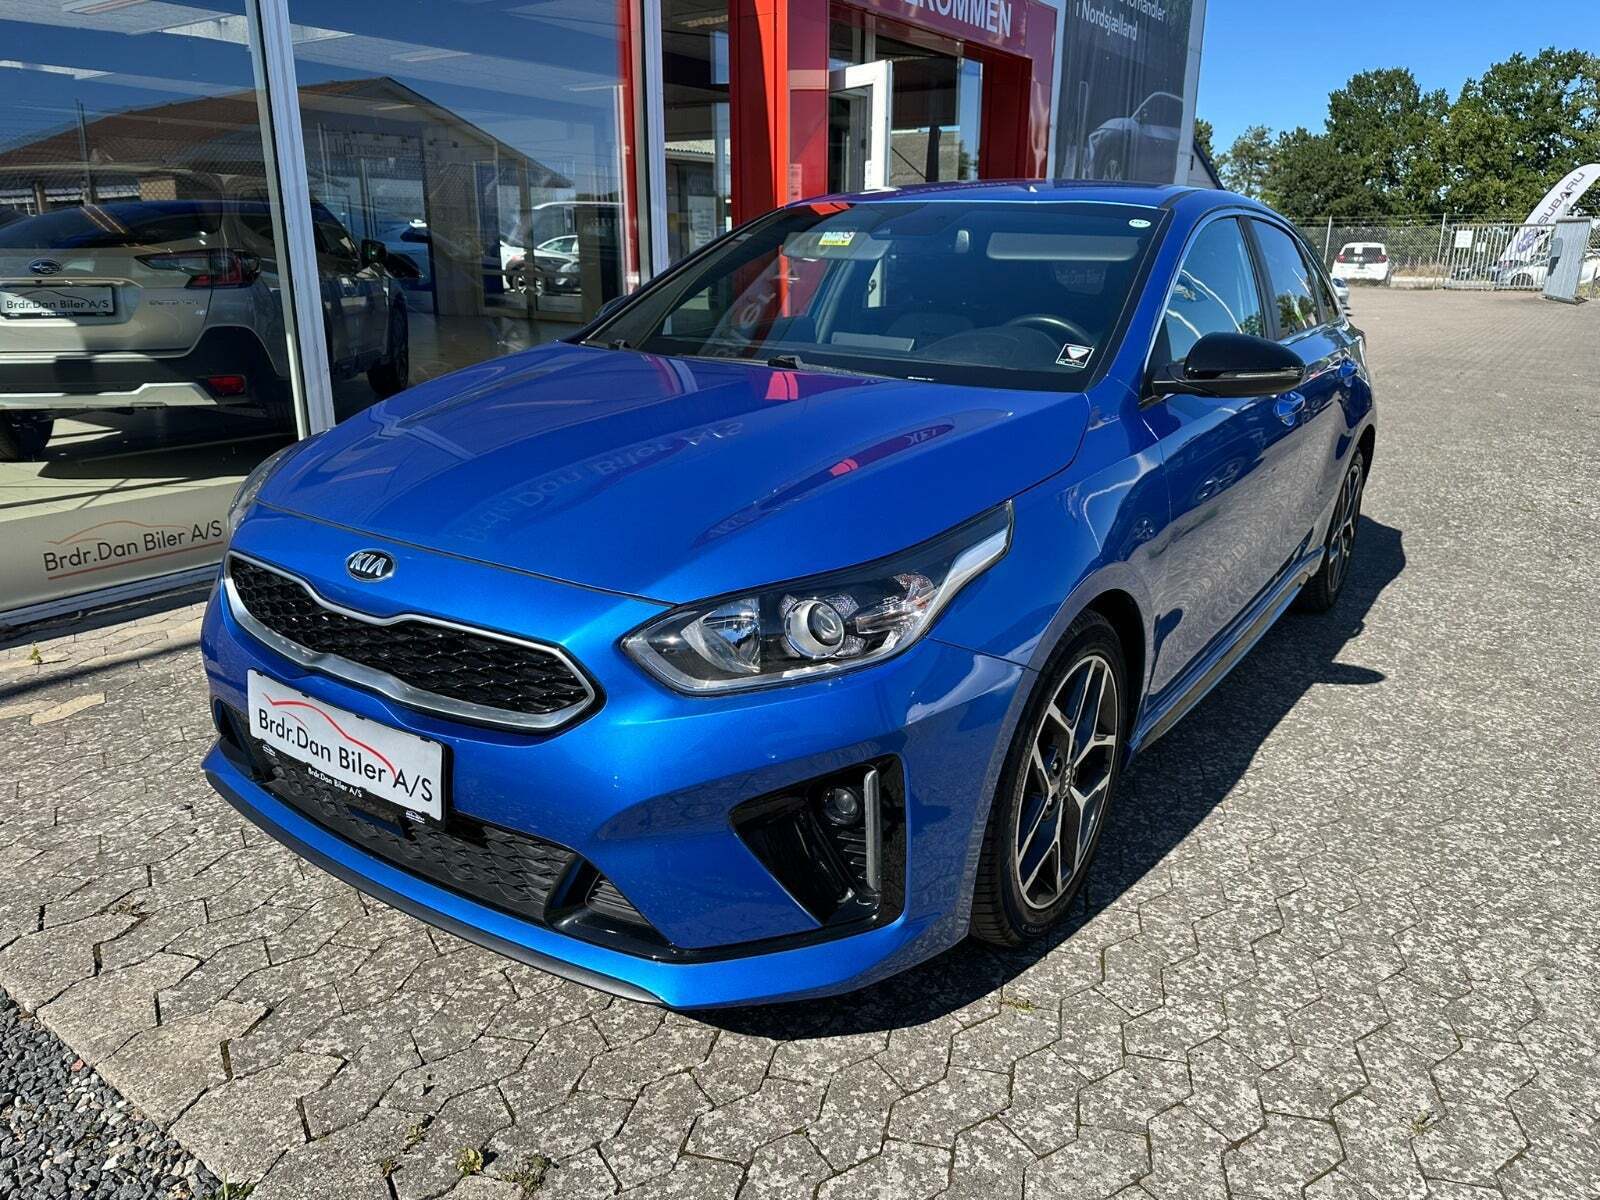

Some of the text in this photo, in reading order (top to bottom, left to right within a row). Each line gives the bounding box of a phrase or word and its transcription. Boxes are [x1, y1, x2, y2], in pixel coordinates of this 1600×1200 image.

[1081, 0, 1138, 41] Nordsjælland
[1537, 172, 1586, 225] SUBARU
[60, 300, 85, 309] Biler
[88, 300, 109, 309] A/S
[143, 530, 185, 552] Biler
[191, 520, 222, 542] A/S
[350, 552, 387, 577] KIA
[333, 779, 348, 791] Biler
[349, 786, 363, 798] A/S
[338, 746, 386, 783] Biler
[393, 768, 433, 802] A/S
